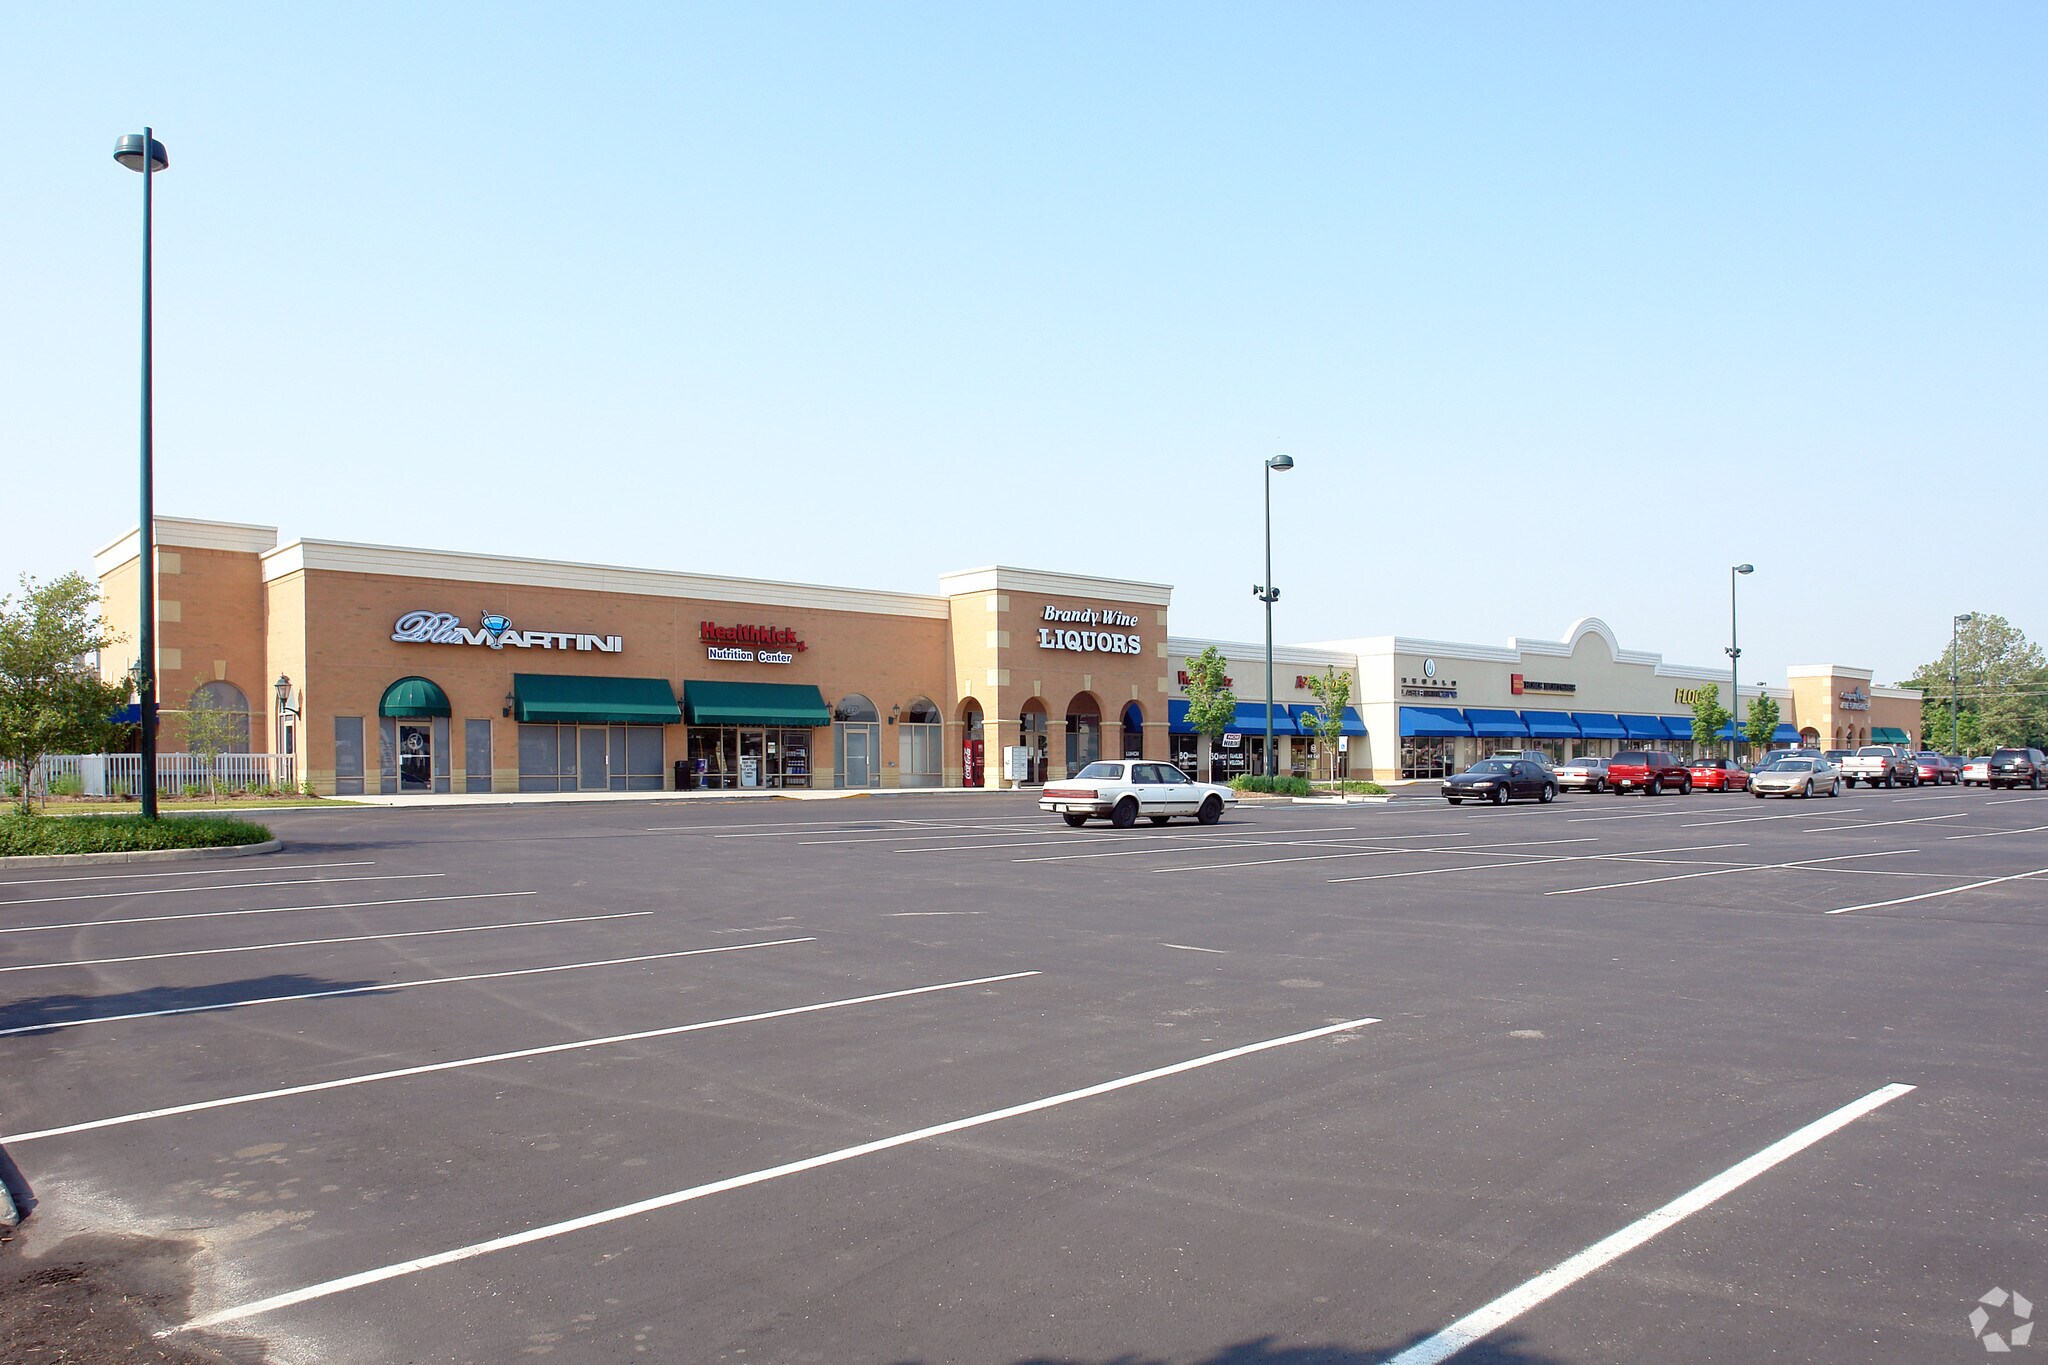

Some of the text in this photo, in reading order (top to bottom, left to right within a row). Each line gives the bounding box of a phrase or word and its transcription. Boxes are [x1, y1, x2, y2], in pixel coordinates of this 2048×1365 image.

[1044, 605, 1138, 626] Brandy Wine
[455, 627, 622, 652] MARTINI
[1039, 628, 1141, 654] LIQUORS
[708, 647, 792, 663] Nutrition Center
